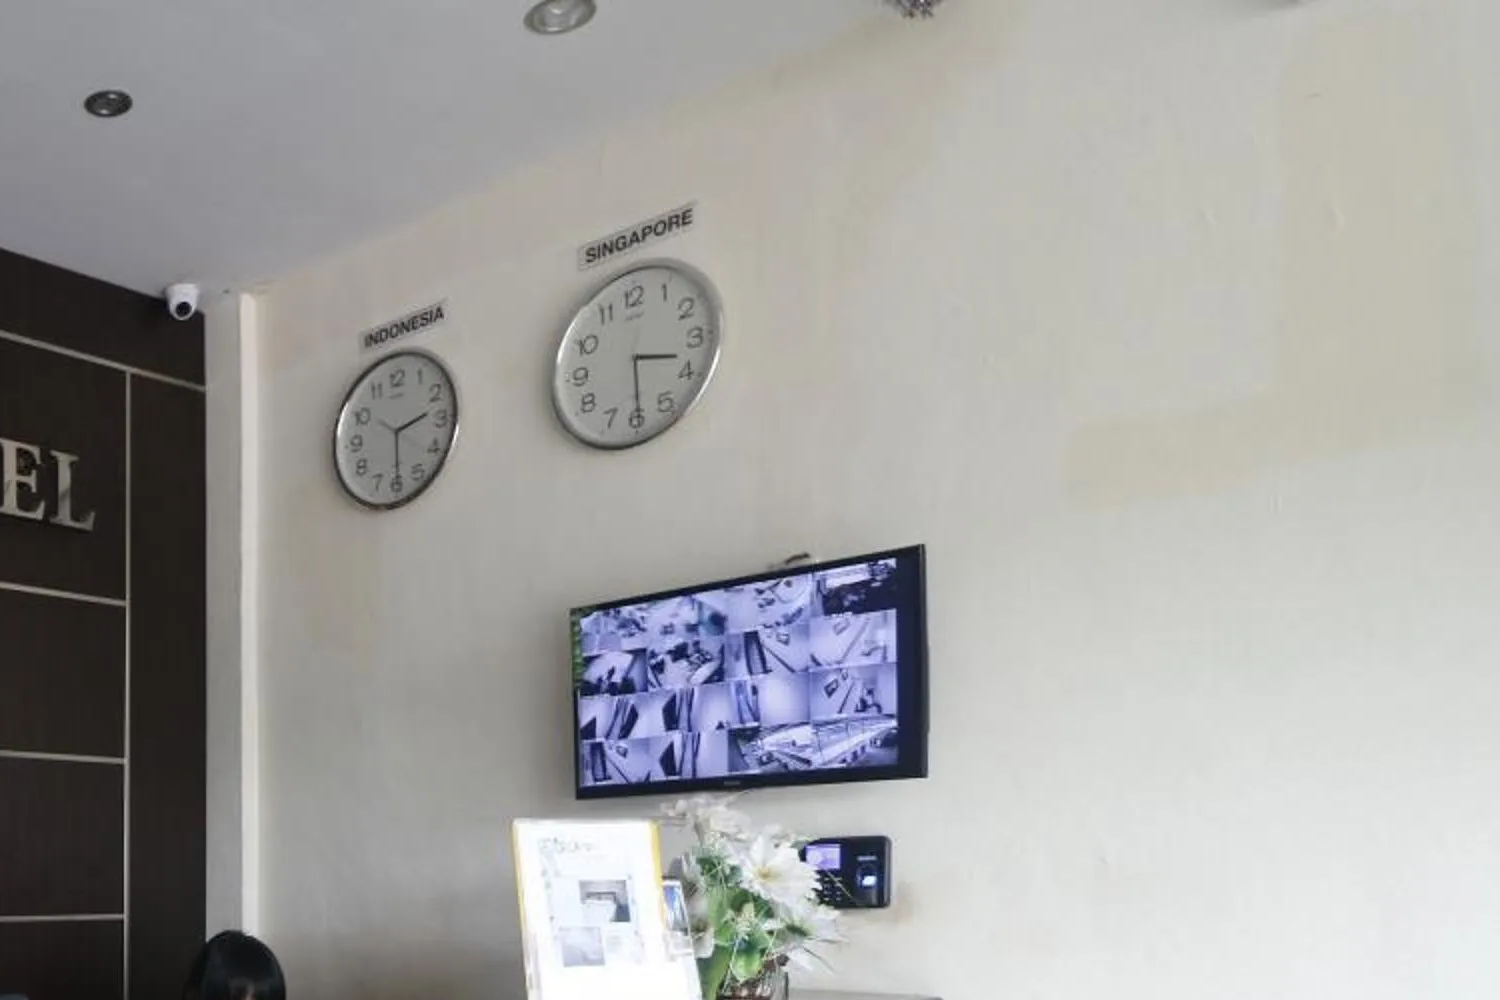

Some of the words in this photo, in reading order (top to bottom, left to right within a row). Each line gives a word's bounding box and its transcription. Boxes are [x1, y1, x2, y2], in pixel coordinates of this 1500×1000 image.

[585, 207, 693, 263] SINGAPORE
[624, 285, 645, 309] 12
[661, 283, 668, 301] 1
[599, 303, 614, 325] 11
[677, 297, 695, 321] 2
[364, 305, 444, 348] INDONESIA
[577, 334, 599, 356] 10
[686, 327, 704, 349] 3
[389, 368, 406, 388] 12
[417, 367, 423, 385] 1
[572, 366, 589, 387] 9
[677, 359, 695, 381] 4
[371, 382, 382, 400] 11
[429, 383, 444, 402] 2
[580, 392, 597, 413] 8
[657, 391, 675, 413] 5
[355, 407, 371, 426] 10
[435, 408, 448, 428] 3
[603, 407, 619, 429] 7
[628, 407, 645, 429] 6
[350, 434, 363, 453] 9
[427, 437, 441, 455] 4
[356, 458, 368, 476] 8
[411, 463, 425, 481] 5
[372, 473, 383, 492] 7
